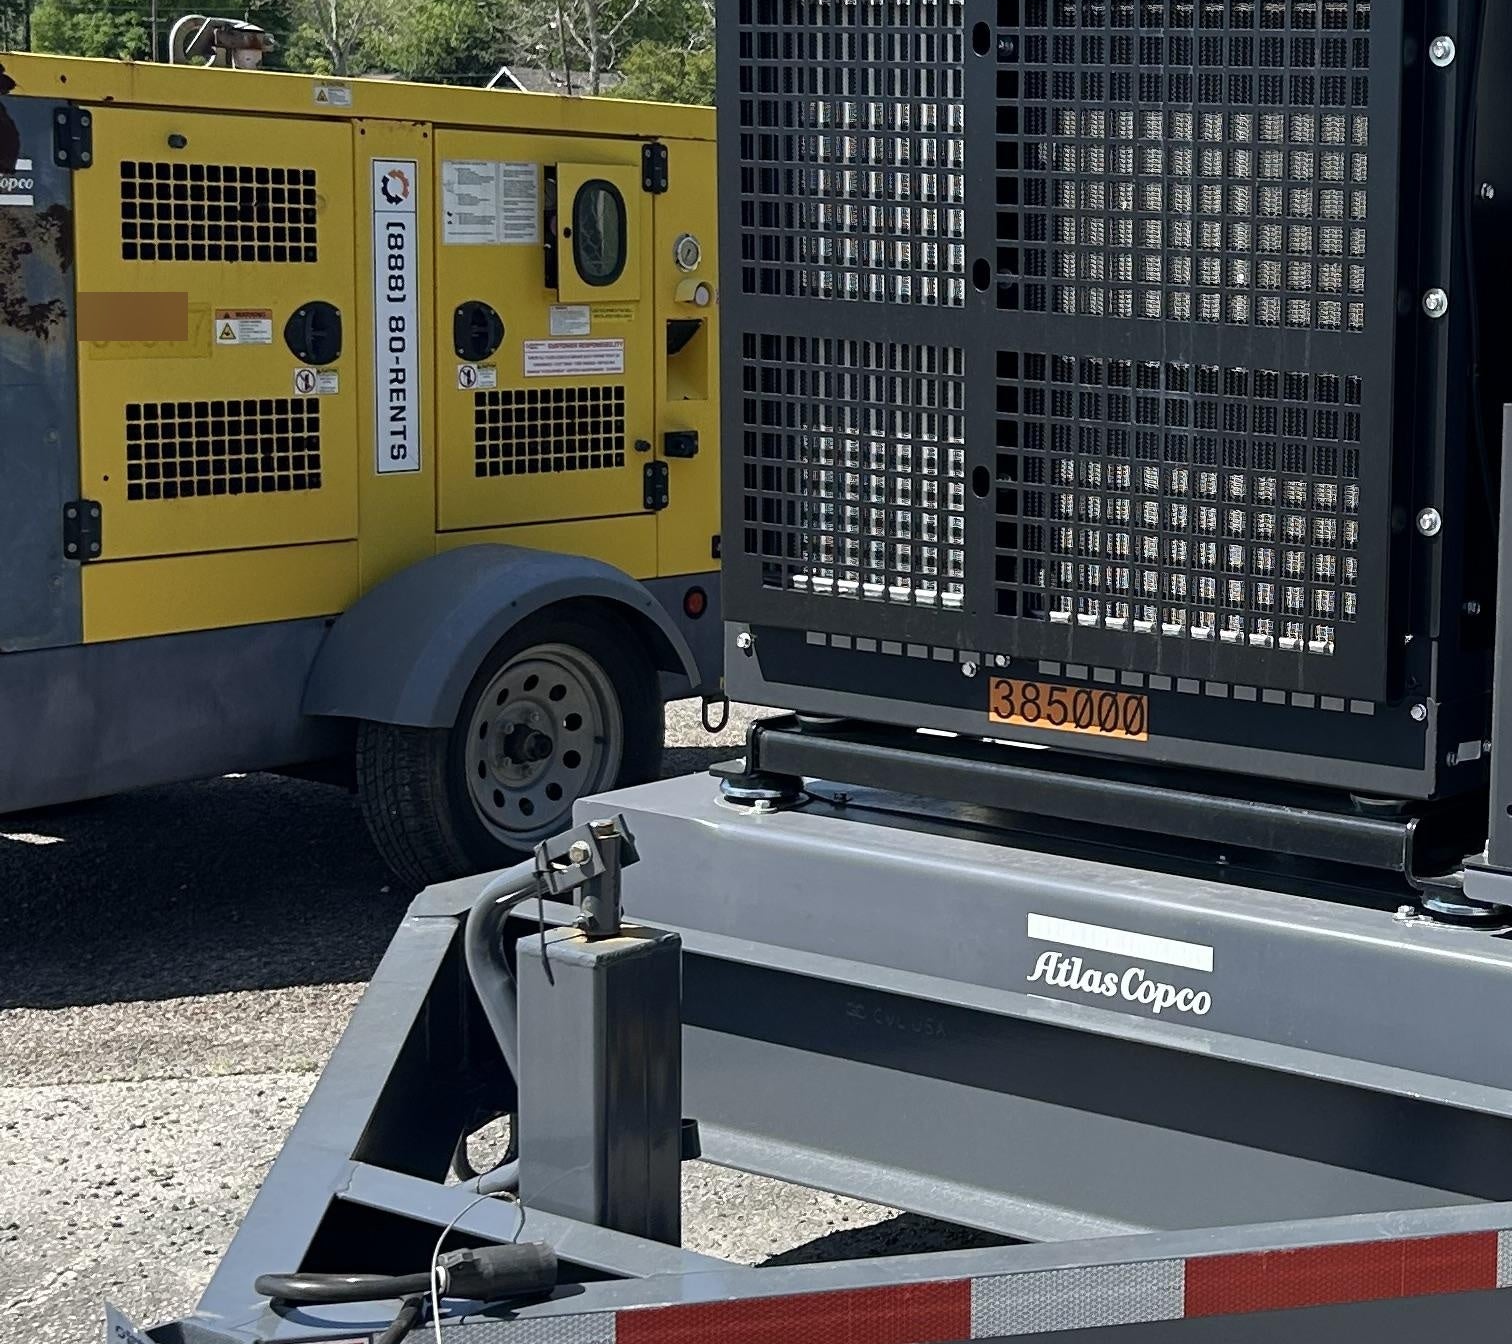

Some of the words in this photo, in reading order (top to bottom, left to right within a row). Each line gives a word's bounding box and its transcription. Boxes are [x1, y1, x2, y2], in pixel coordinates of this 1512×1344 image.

[386, 221, 407, 304] (888)
[388, 316, 408, 461] 80-RENTS
[993, 679, 1146, 736] 385000
